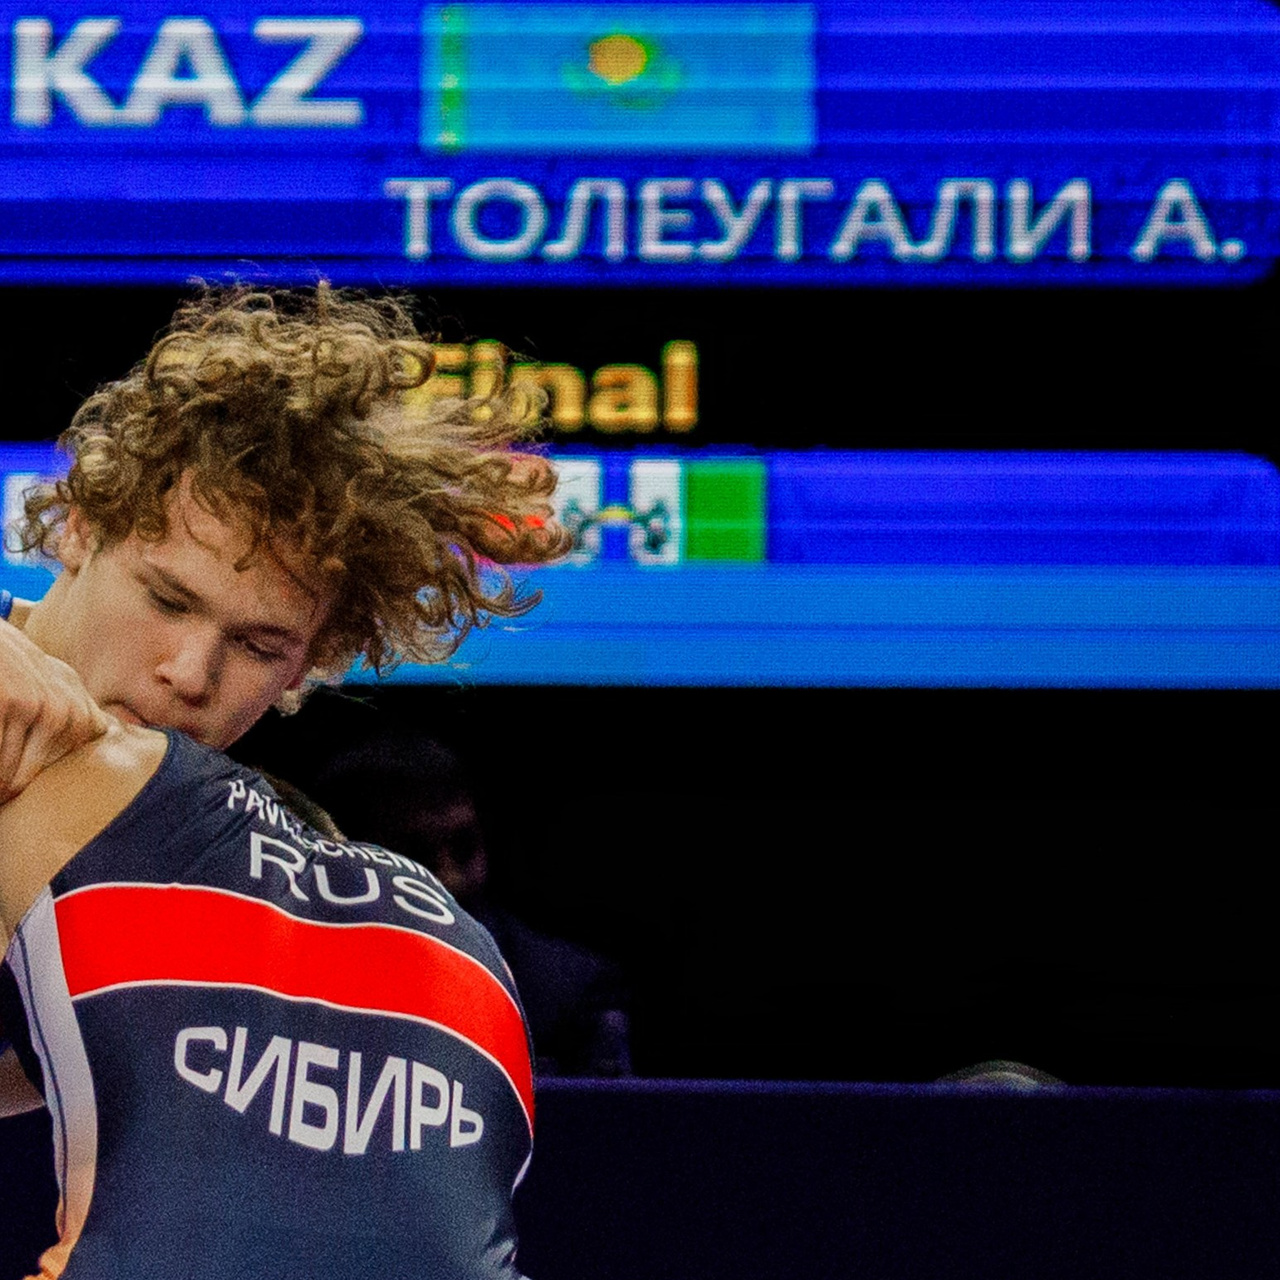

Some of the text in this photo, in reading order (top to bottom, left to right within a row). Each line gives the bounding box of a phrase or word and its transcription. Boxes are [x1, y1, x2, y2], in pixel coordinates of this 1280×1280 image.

[11, 18, 364, 127] KAZ
[385, 177, 1246, 263] ТОЛЕУГАЛИ А.
[402, 338, 698, 434] Final
[250, 831, 455, 925] RUS
[174, 1026, 484, 1155] СИБИРЬ
